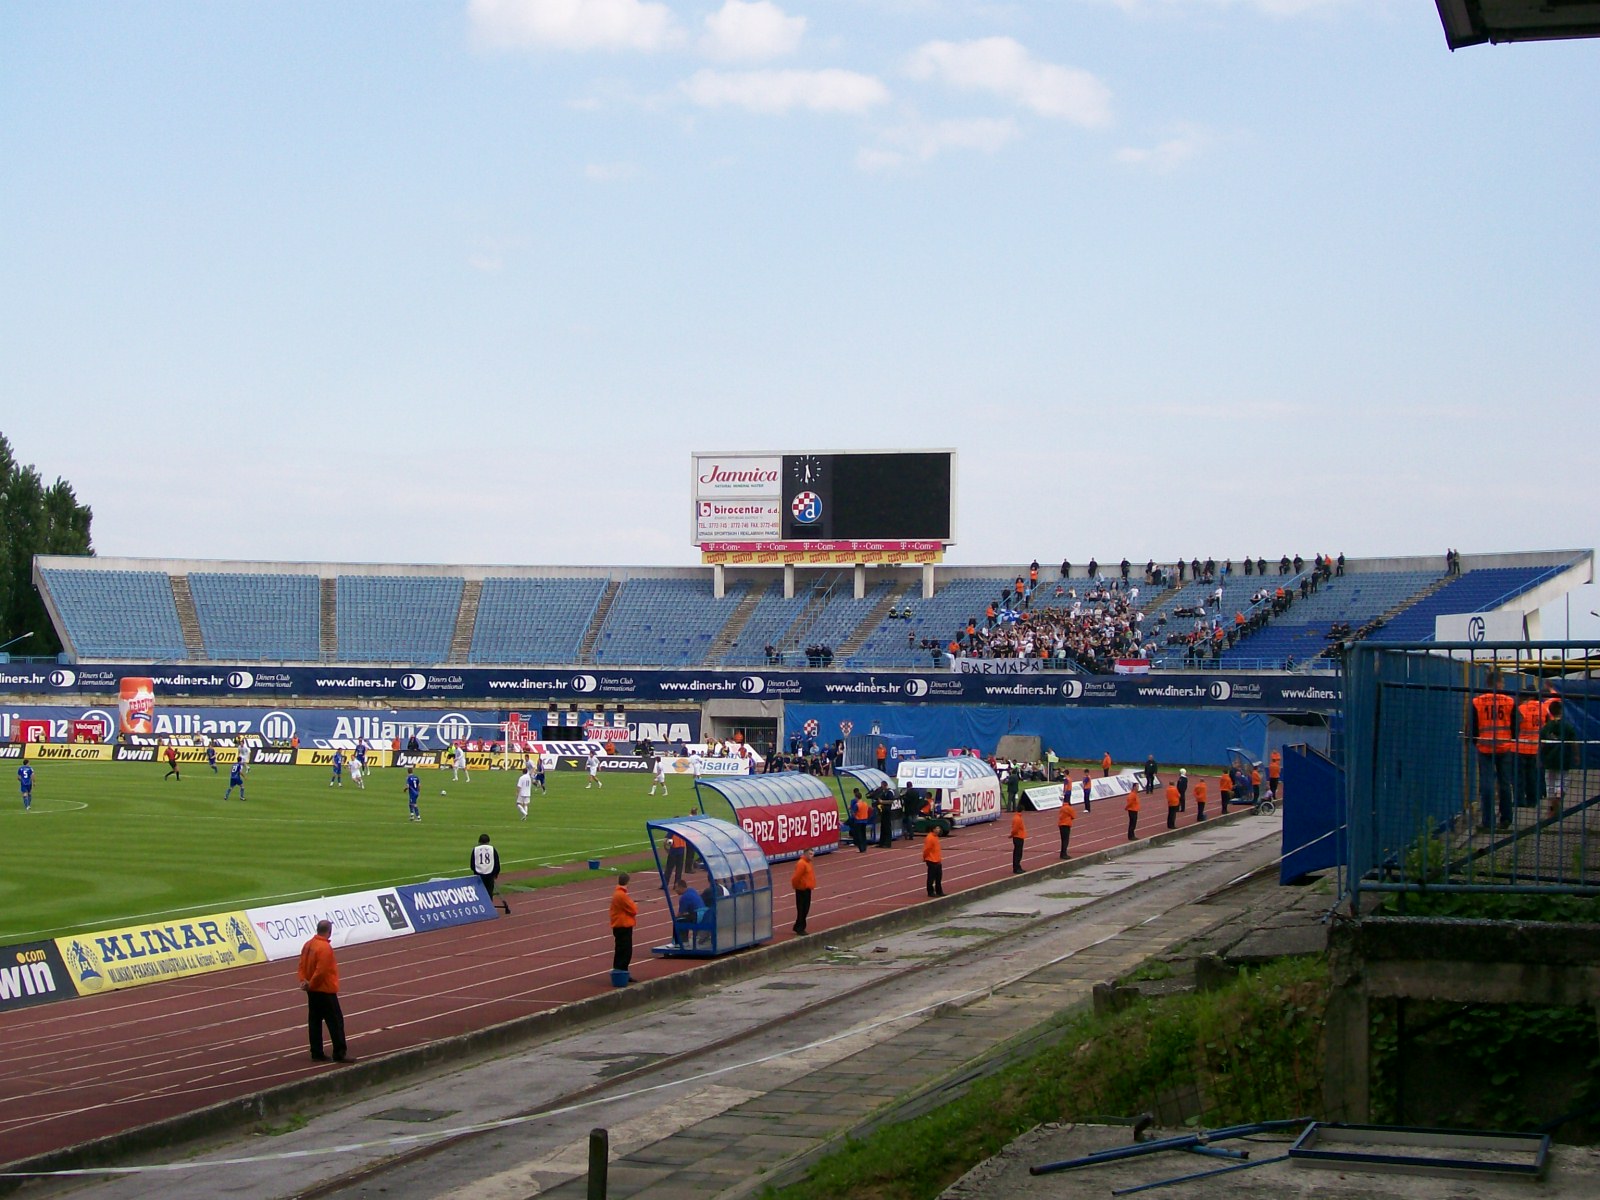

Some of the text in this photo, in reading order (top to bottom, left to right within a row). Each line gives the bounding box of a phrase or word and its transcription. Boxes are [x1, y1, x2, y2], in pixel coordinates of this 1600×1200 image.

[699, 465, 778, 484] Jamnica
[714, 505, 764, 514] birocentar
[0, 673, 46, 684] iners.hr
[79, 672, 114, 680] Diners Club
[316, 677, 397, 688] www.diners.hr
[489, 679, 568, 689] www.diners.hr
[660, 680, 736, 690] www.diners.hr
[826, 682, 900, 693] www.diners.hr
[930, 680, 962, 688] Diners Club
[1084, 681, 1116, 690] Diners Club
[1232, 683, 1260, 692] Diners Club
[986, 684, 1057, 696] www.diners.hr
[1138, 686, 1207, 698] www.diners.hr
[154, 714, 252, 734] Allianz
[333, 716, 430, 740] Allianz
[588, 728, 629, 740] DIDI SOUND
[38, 746, 100, 758] bwin.com
[117, 746, 154, 761] bwin
[254, 749, 292, 763] bwin
[396, 753, 436, 766] bwin
[788, 816, 808, 838] PBZ
[820, 810, 838, 832] PBZ
[754, 820, 774, 843] PBZ
[480, 852, 490, 864] 18
[412, 886, 480, 911] MULTIPOWER
[420, 904, 486, 924] SPORTSFOOD
[266, 904, 380, 940] CROATIA AIRLINES
[96, 921, 226, 963] MLINAR
